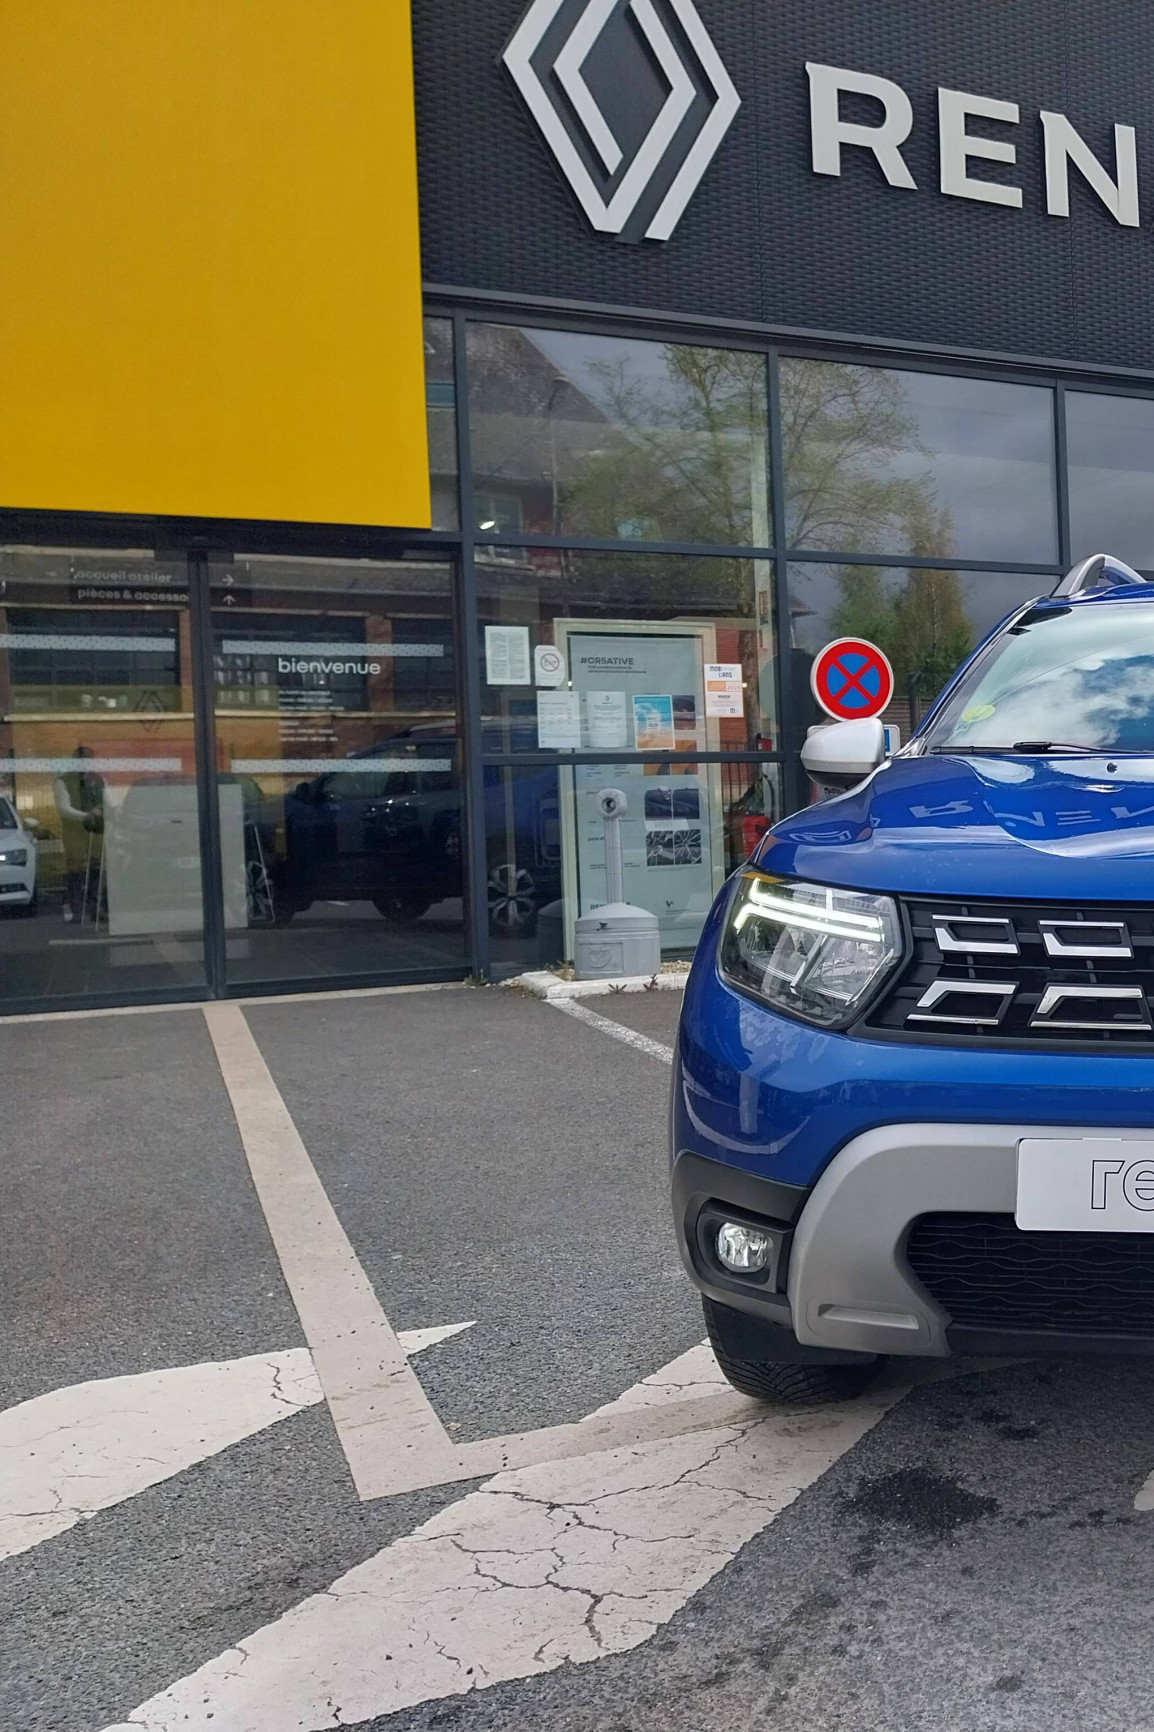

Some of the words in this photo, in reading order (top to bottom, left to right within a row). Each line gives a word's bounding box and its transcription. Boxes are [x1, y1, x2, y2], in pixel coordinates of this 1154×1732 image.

[128, 572, 172, 583] atelier
[122, 590, 132, 600] &
[278, 657, 381, 675] bienvenue
